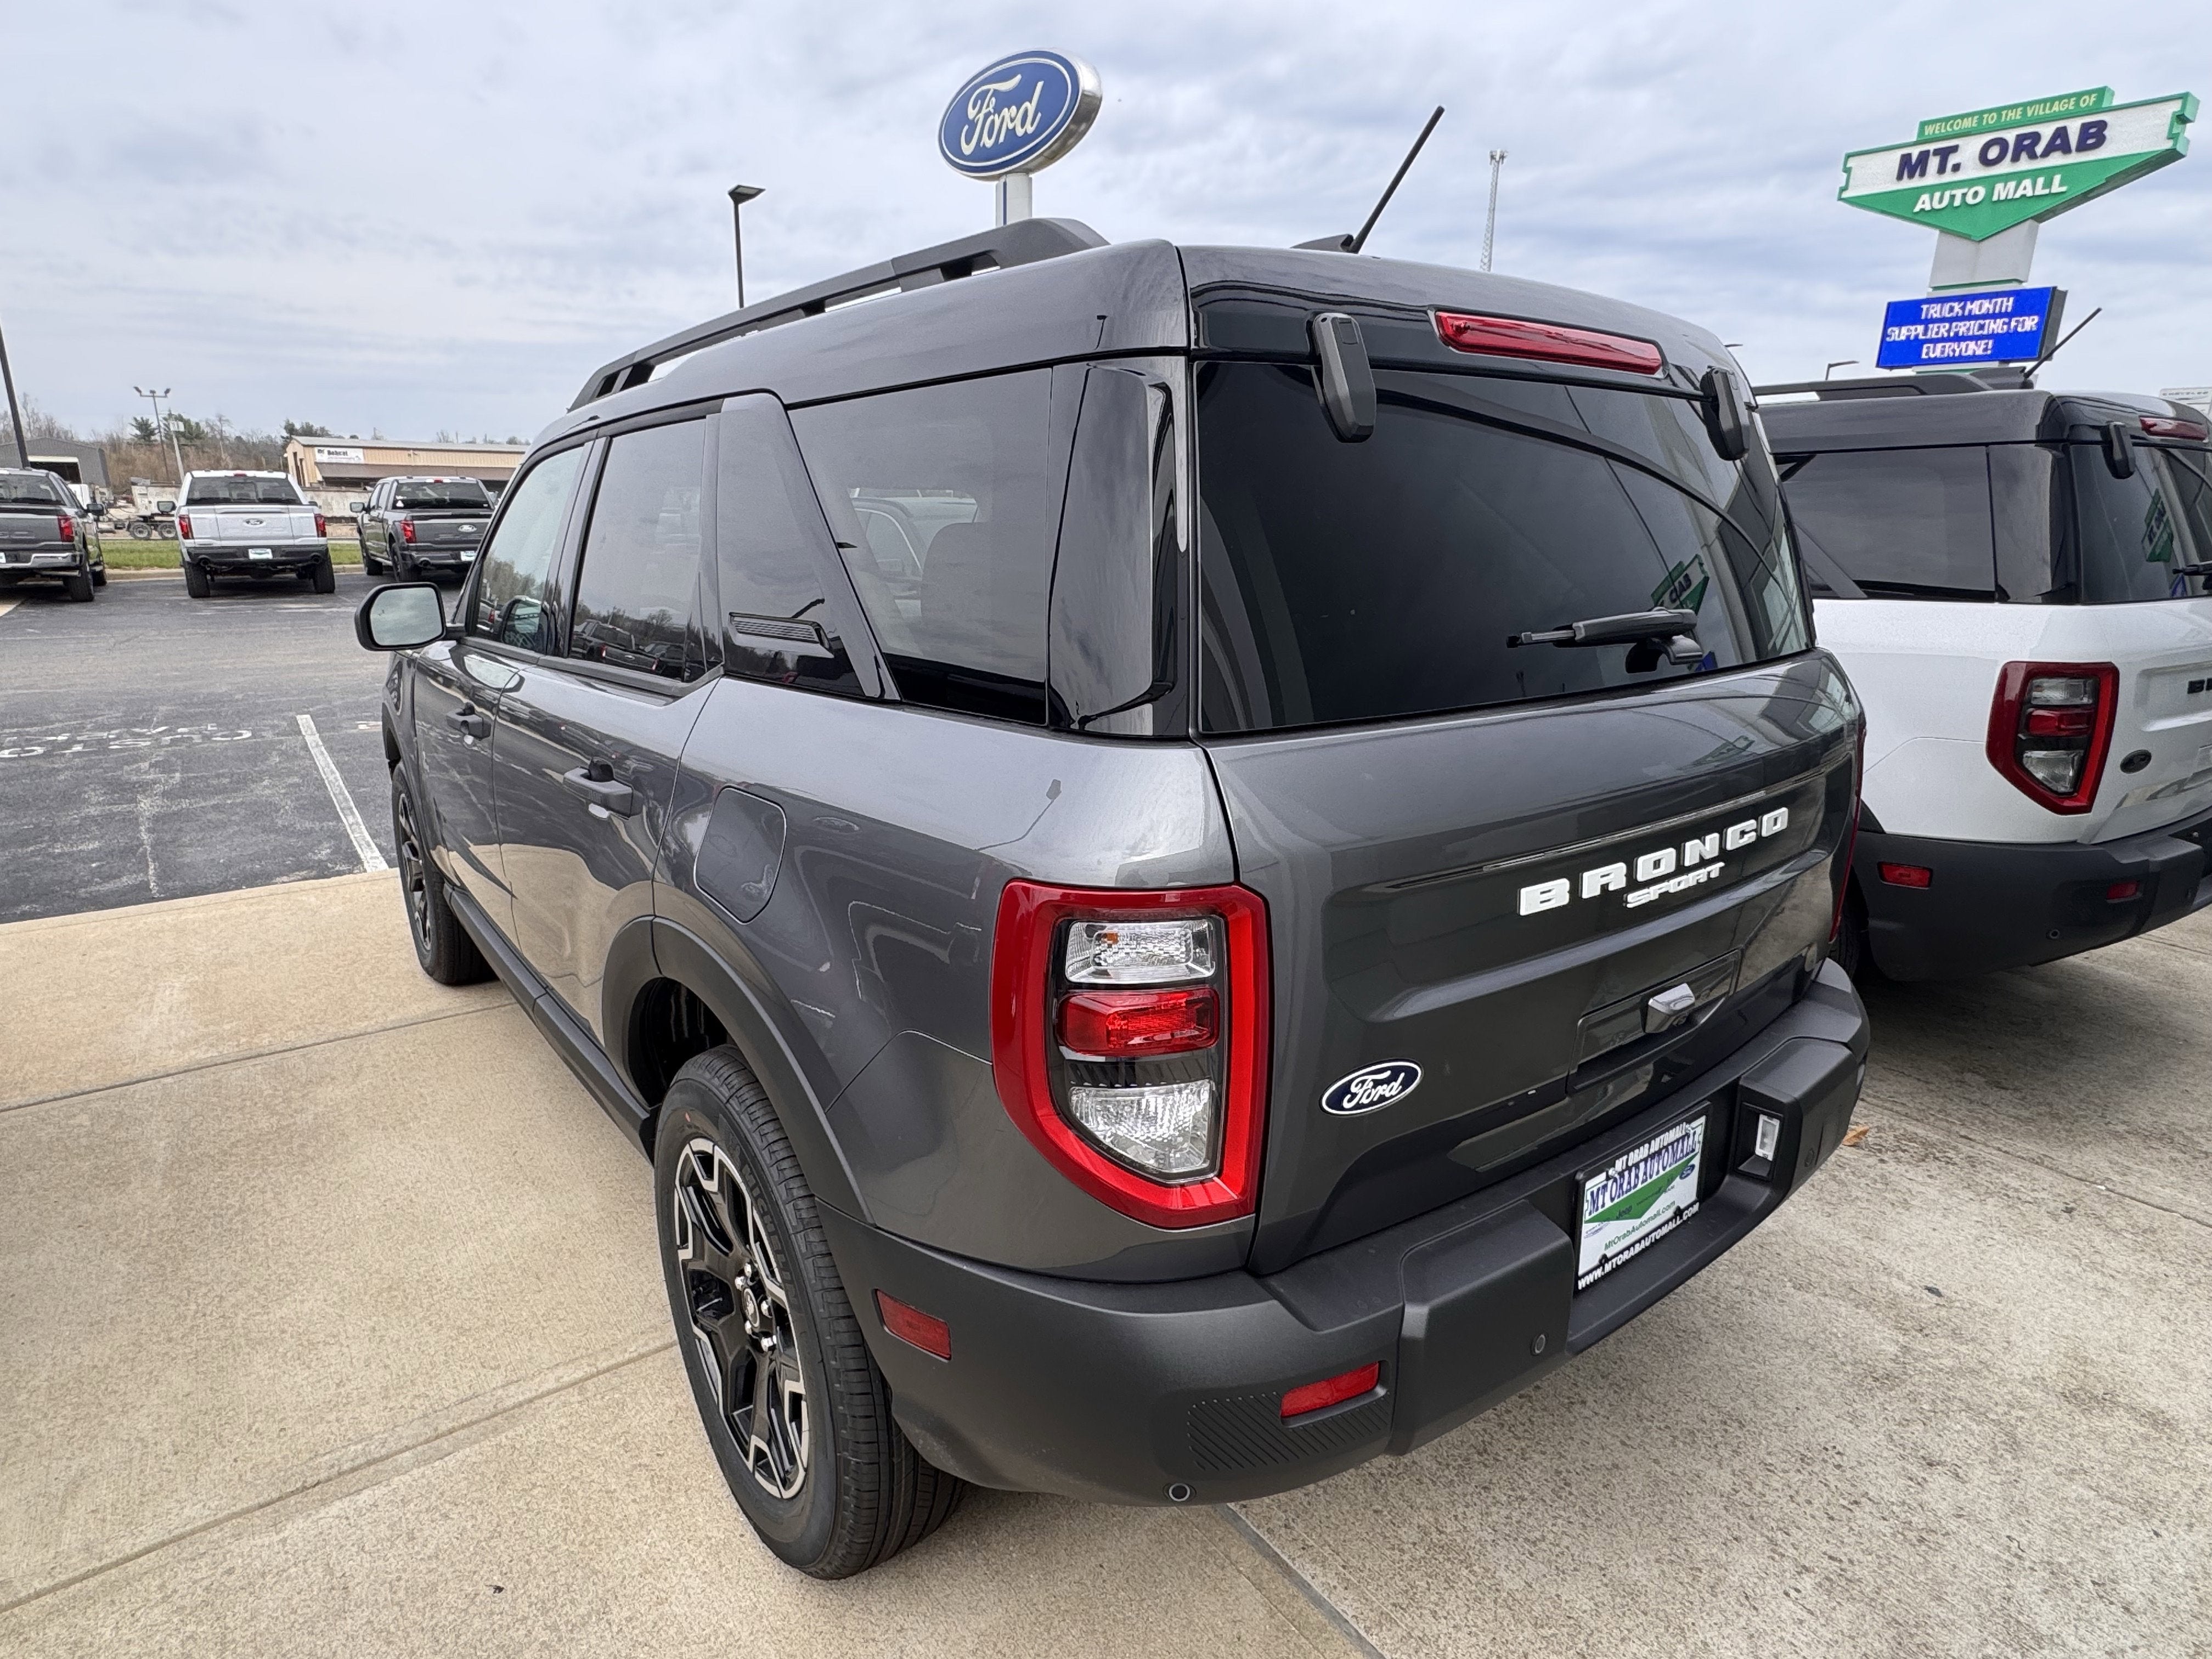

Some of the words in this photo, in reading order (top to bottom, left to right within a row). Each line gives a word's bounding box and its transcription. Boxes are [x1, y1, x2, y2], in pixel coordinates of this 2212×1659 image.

[961, 74, 1044, 156] Ford
[1924, 115, 1979, 136] WELCOME
[1982, 112, 1997, 126] TO
[2001, 107, 2023, 121] THE
[2026, 97, 2076, 117] VILLAGE
[2079, 93, 2098, 107] OF
[1896, 144, 1961, 181] MT.
[1978, 119, 2108, 167] ORAB
[1912, 185, 1986, 213] AUTO
[1991, 174, 2068, 202] MALL
[1886, 322, 1949, 342] SUPPLIER
[1950, 318, 2009, 337] PRICING
[2010, 315, 2039, 333] FOR
[1921, 301, 1964, 319] TRUCK
[1964, 297, 2014, 316] MONTH
[1921, 339, 1994, 359] EVERYONE!
[1517, 806, 1788, 916] BRONCO
[1624, 861, 1725, 908] SPORT
[1342, 1070, 1405, 1108] Ford
[1588, 1183, 1608, 1216] MT
[1610, 1165, 1639, 1203] ORAB
[1640, 1130, 1696, 1185] AUTOMALL
[1615, 1155, 1628, 1172] MT
[1578, 1201, 1700, 1290] WWW.MTORABAUTOMALL.COM
